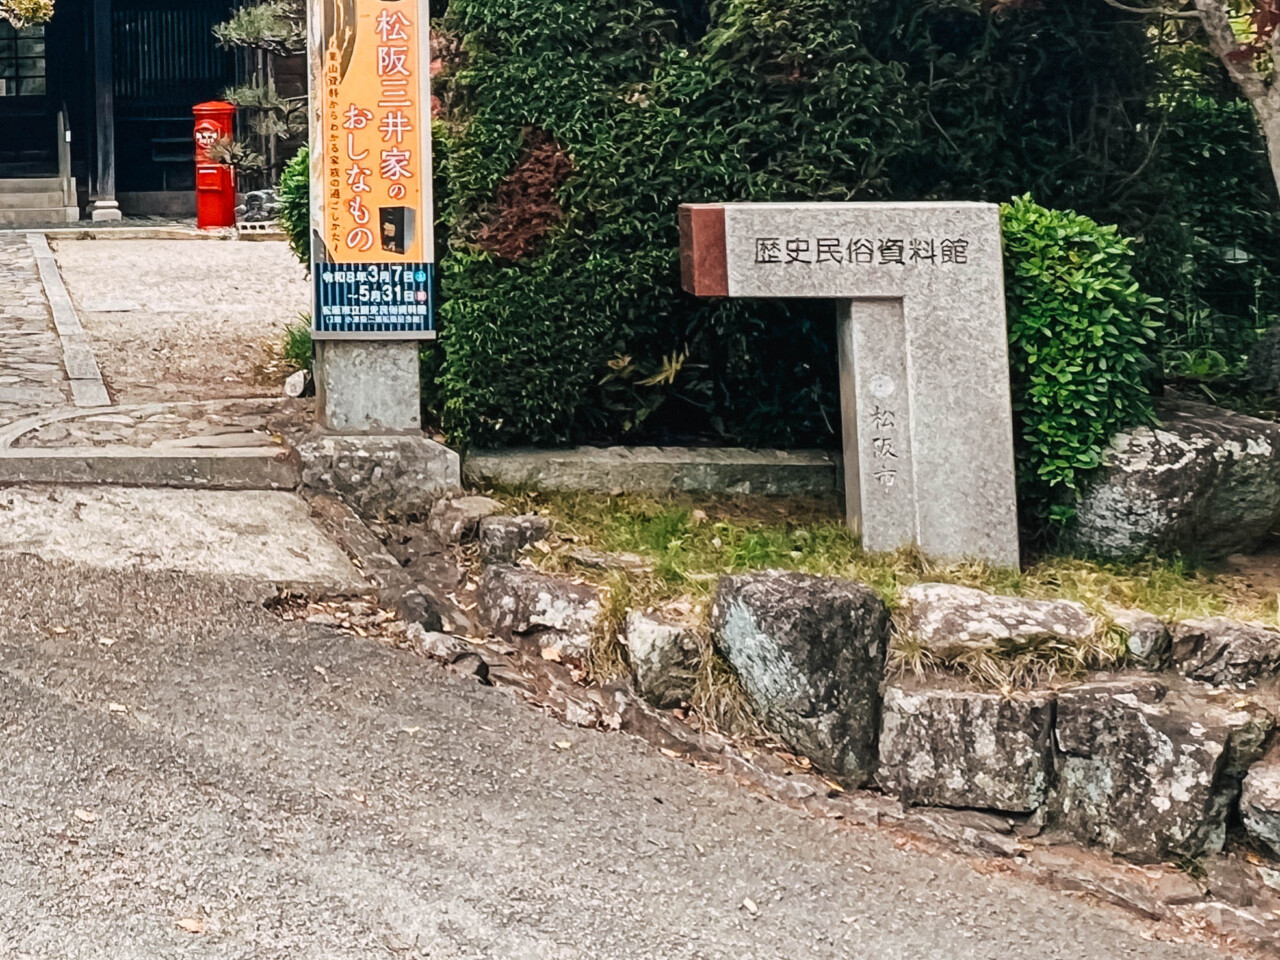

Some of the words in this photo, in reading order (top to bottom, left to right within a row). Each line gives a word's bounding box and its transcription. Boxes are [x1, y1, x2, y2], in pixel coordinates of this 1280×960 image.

[376, 9, 412, 200] 松阪三井家の
[342, 102, 374, 252] おしなもの
[754, 237, 970, 266] 歴史民俗資料館
[870, 405, 899, 493] 松阪市
